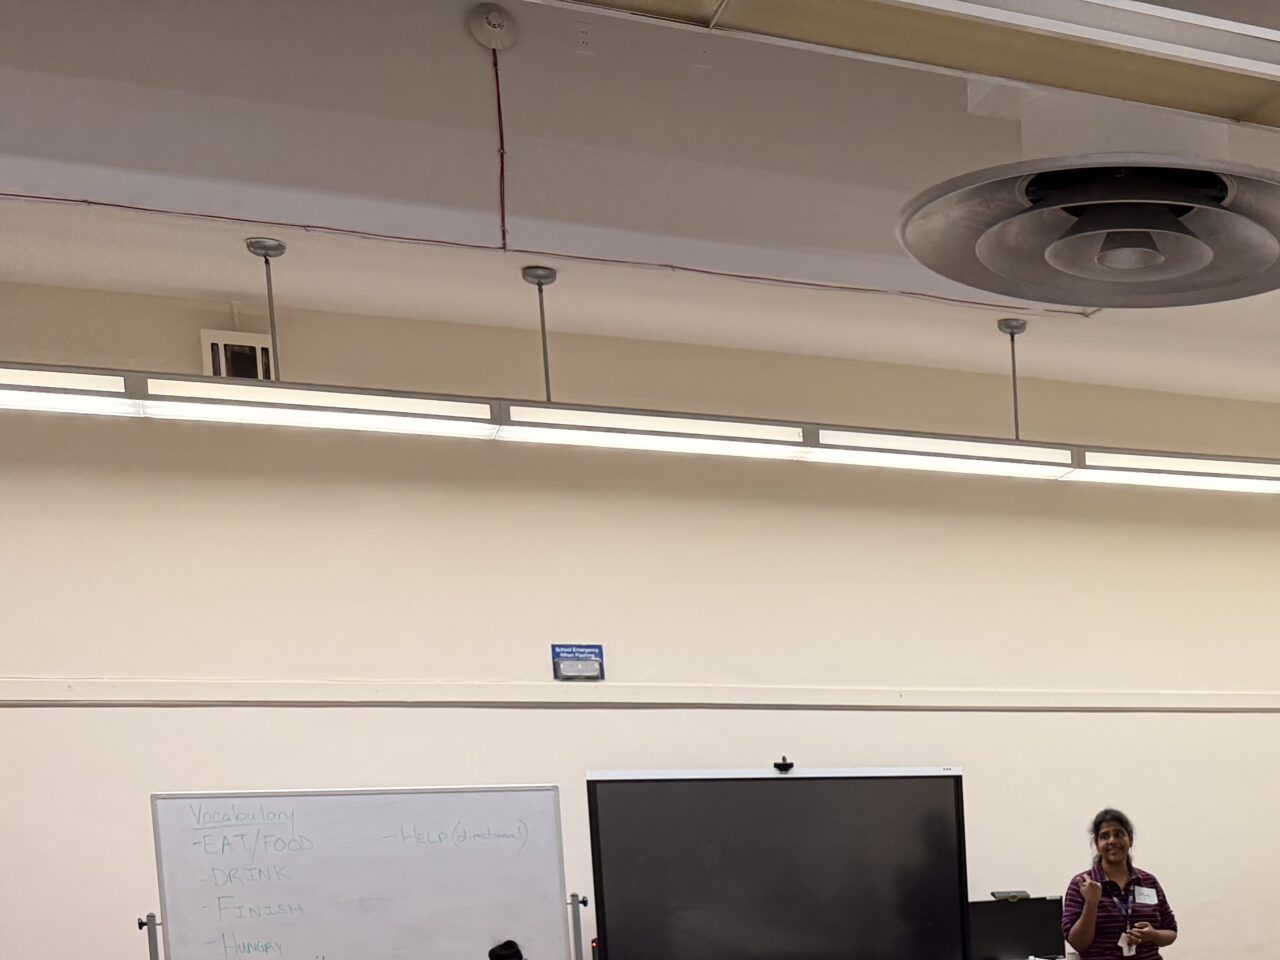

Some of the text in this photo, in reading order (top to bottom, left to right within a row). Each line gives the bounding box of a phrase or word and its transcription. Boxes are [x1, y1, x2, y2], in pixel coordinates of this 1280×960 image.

[189, 803, 295, 838] Vocabulary
[400, 823, 448, 846] HELP
[211, 865, 293, 888] DRINK
[217, 895, 304, 922] FINISH
[221, 930, 283, 960] HUNGRY
